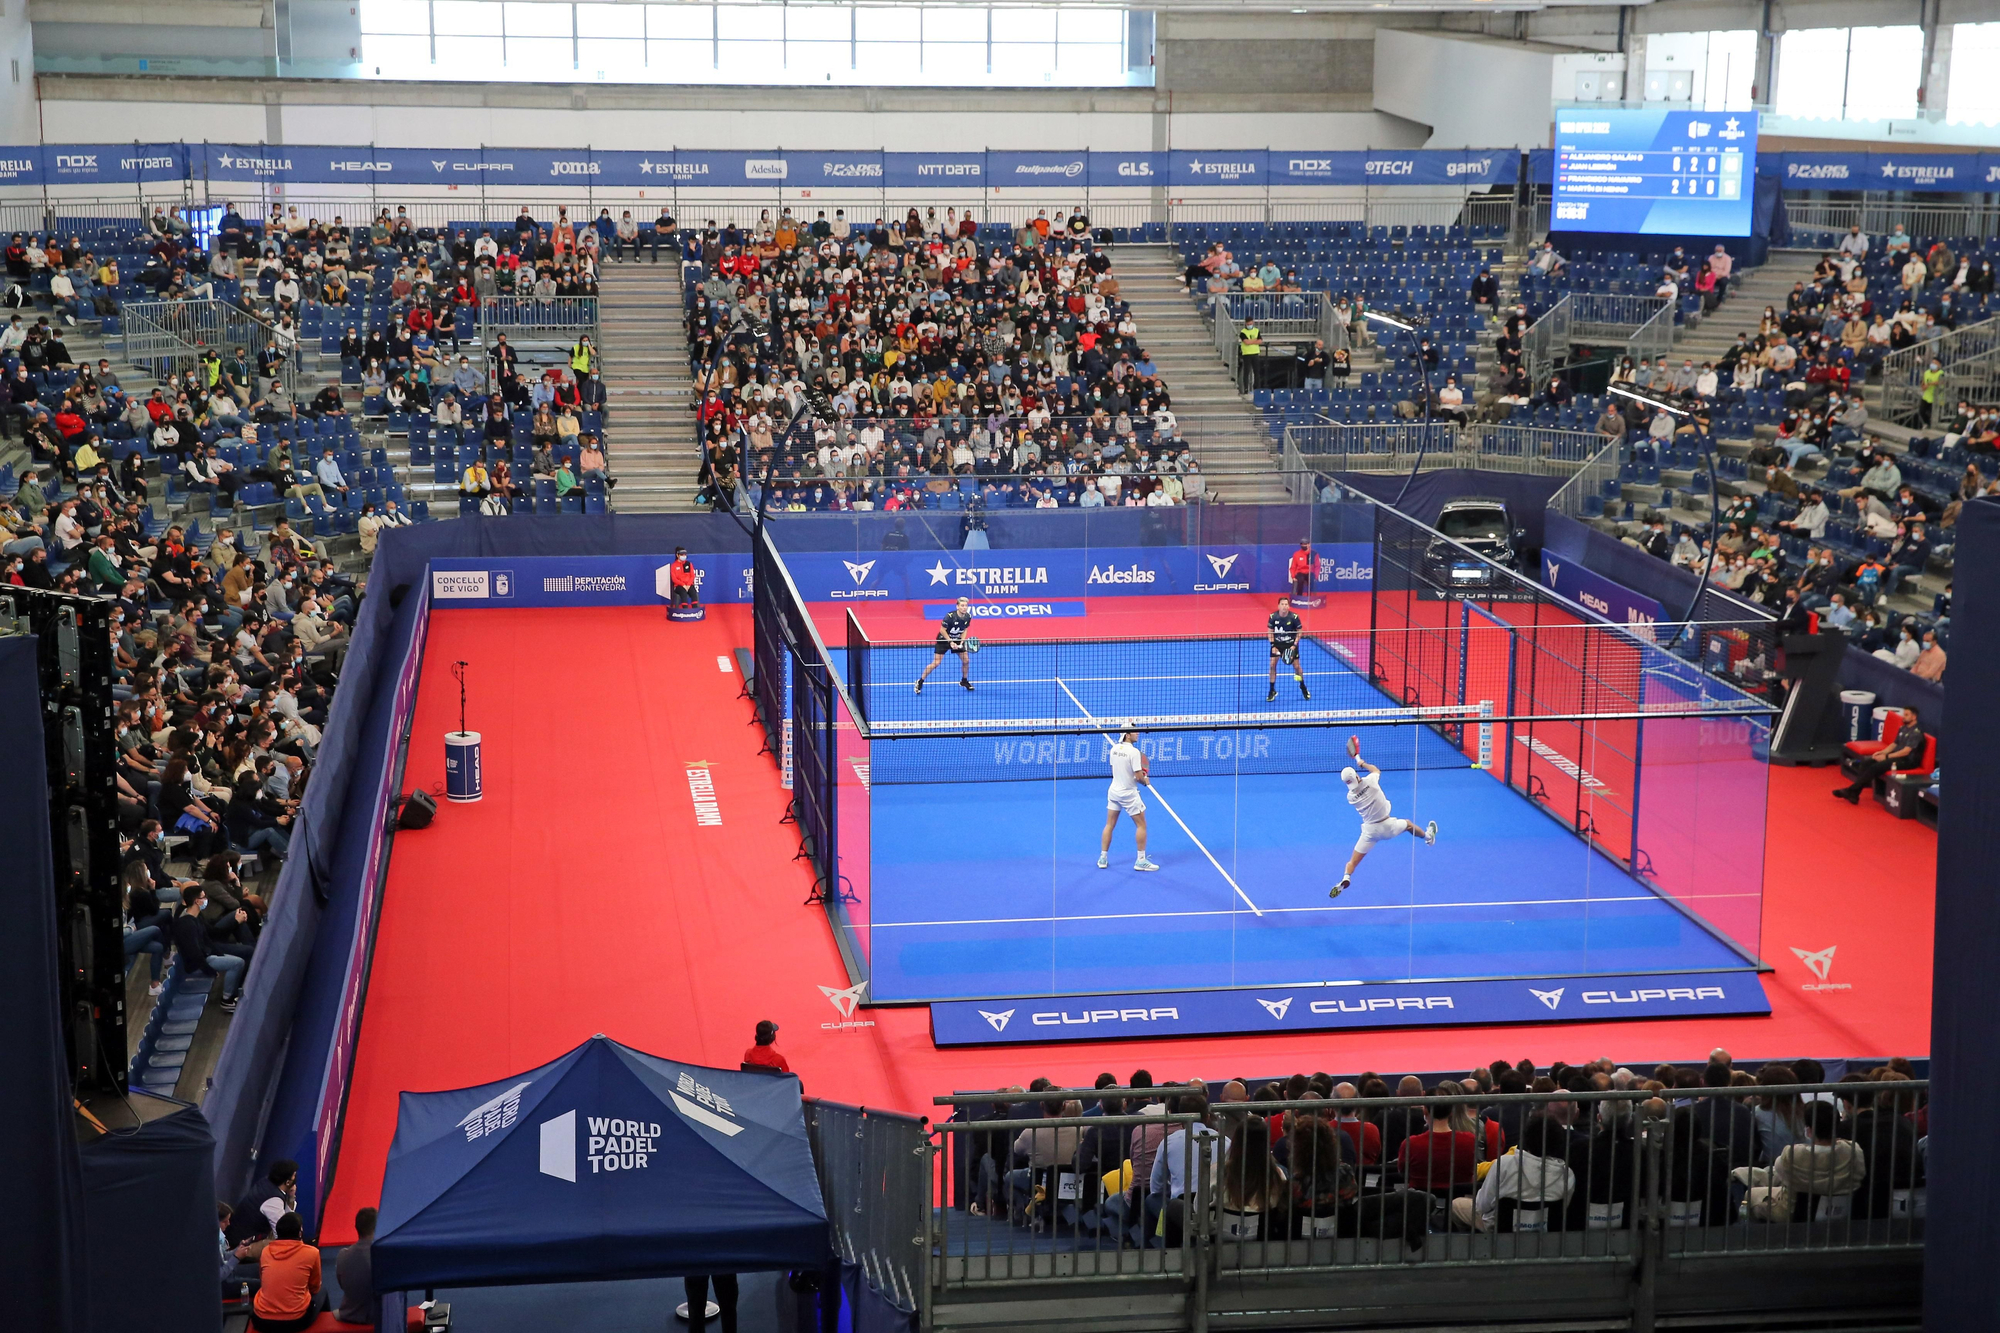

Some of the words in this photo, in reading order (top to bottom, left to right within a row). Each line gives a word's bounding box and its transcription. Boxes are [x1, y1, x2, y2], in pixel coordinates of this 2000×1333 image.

[236, 159, 292, 170] ESTRELLA
[330, 161, 392, 172] HEAD
[453, 163, 513, 171] CUPRA
[656, 163, 709, 174] ESTRELLA
[751, 164, 782, 175] Adeslas
[918, 164, 944, 175] NTT
[1205, 163, 1255, 173] ESTRELLA
[1690, 156, 1698, 172] 2
[1015, 165, 1066, 175] Bullpadel
[1898, 166, 1954, 178] ESTRELLA
[1671, 179, 1679, 194] 2
[574, 574, 626, 584] DEPUTACIÓN
[955, 566, 1048, 585] ESTRELLA
[1086, 564, 1156, 584] Adeslas
[437, 576, 484, 585] CONCELLO
[443, 585, 456, 594] DE
[458, 585, 480, 594] VIGO
[574, 584, 627, 592] PONTEVEDRA
[985, 584, 1019, 595] DAMM
[1193, 583, 1250, 591] CUPRA
[830, 589, 888, 598] CUPRA
[1579, 590, 1609, 615] HEAD
[1005, 603, 1053, 615] OPEN
[994, 739, 1091, 765] WORLD
[1101, 734, 1190, 764] PDEL
[1200, 734, 1271, 760] TOUR
[1582, 986, 1726, 1005] CUPRA
[1309, 996, 1455, 1015] CUPRA
[1032, 1007, 1179, 1026] CUPRA
[820, 1020, 875, 1029] CUPRA
[587, 1116, 662, 1138] WORLD
[588, 1136, 658, 1155] PADEL
[587, 1154, 649, 1174] TOUR
